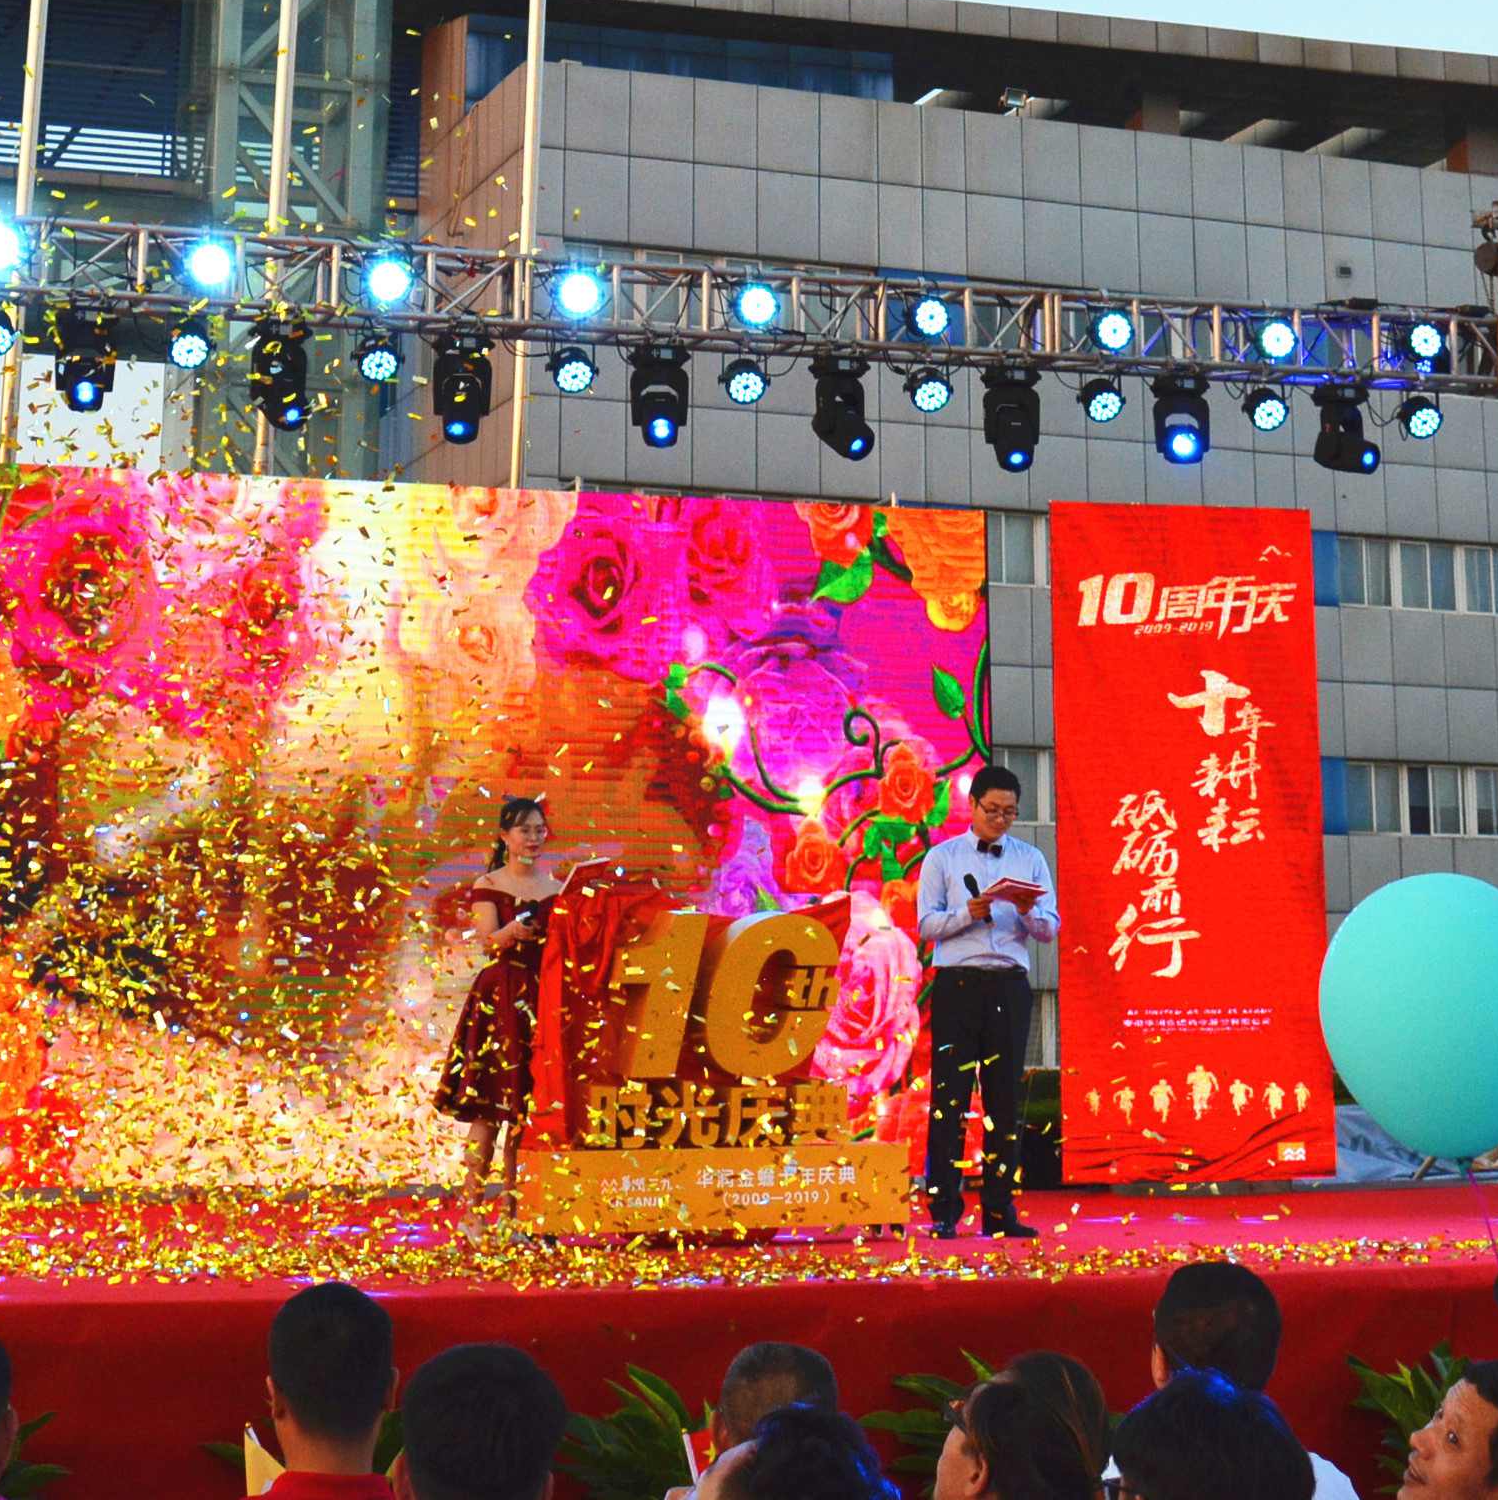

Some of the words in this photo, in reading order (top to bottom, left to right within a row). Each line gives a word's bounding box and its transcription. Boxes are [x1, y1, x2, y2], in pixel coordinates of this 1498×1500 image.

[1167, 669, 1276, 853] 十年耕耘
[1108, 790, 1201, 978] 砥砺前行
[588, 1079, 850, 1150] 时光庆典
